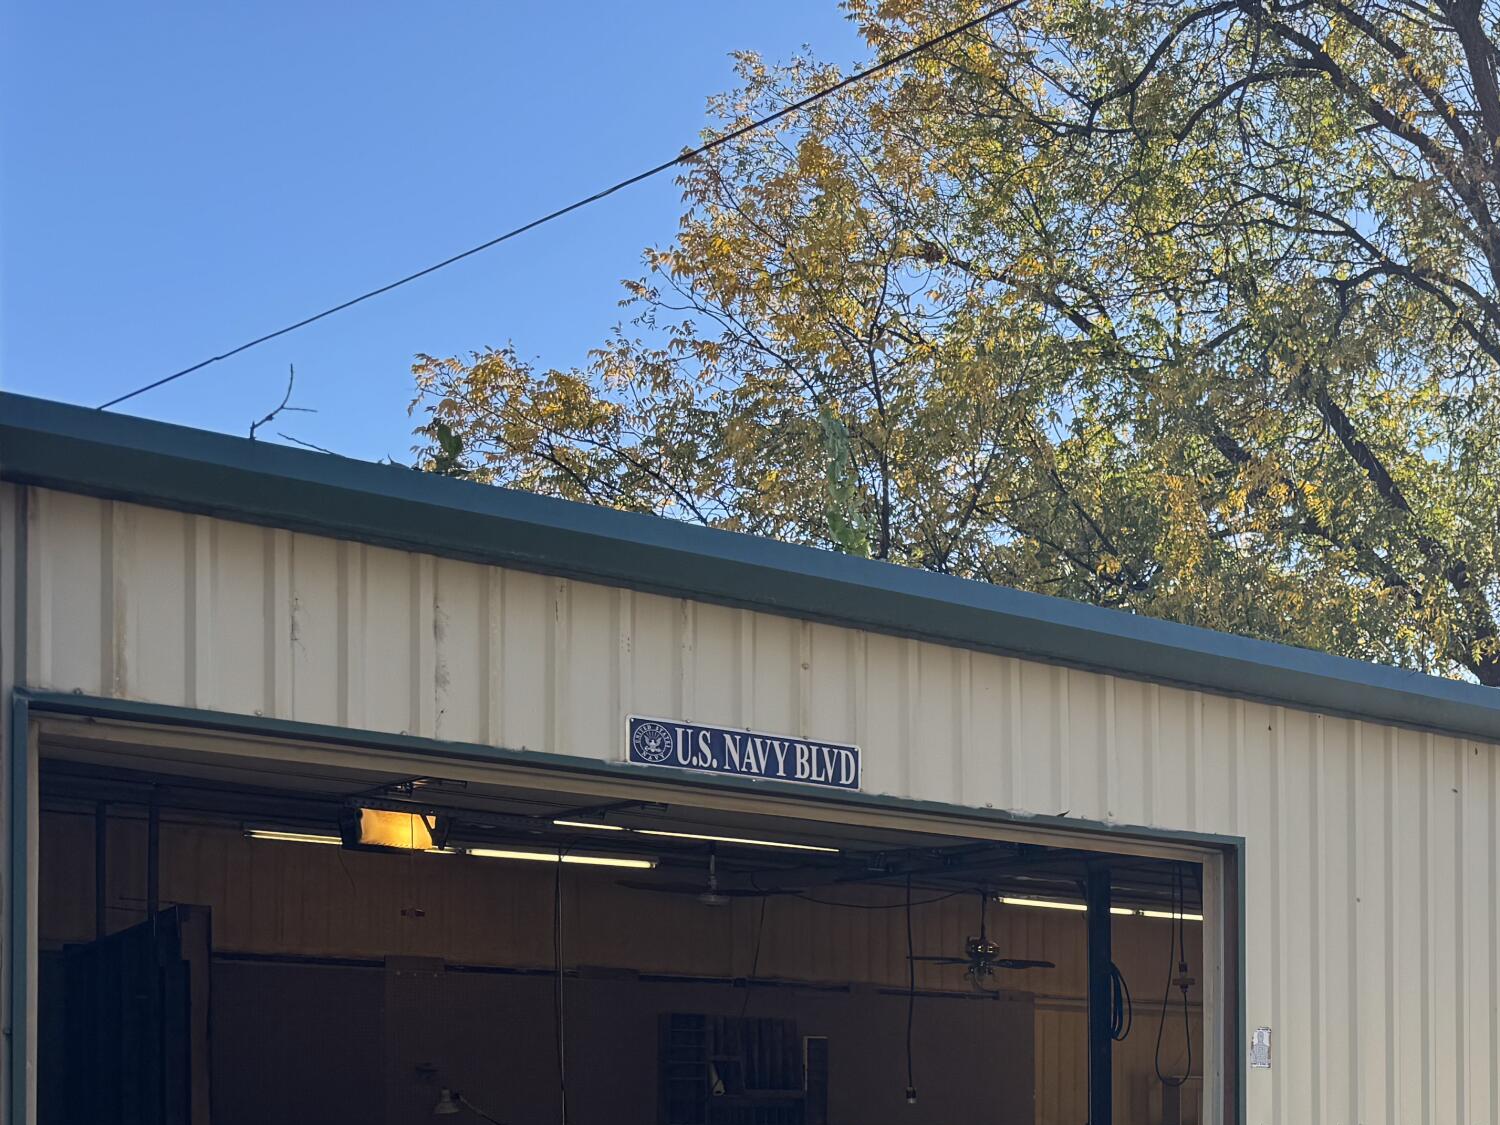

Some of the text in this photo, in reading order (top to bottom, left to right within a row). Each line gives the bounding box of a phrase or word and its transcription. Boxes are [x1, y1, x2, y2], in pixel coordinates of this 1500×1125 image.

[674, 727, 856, 785] U.S. NAVY BLVD
